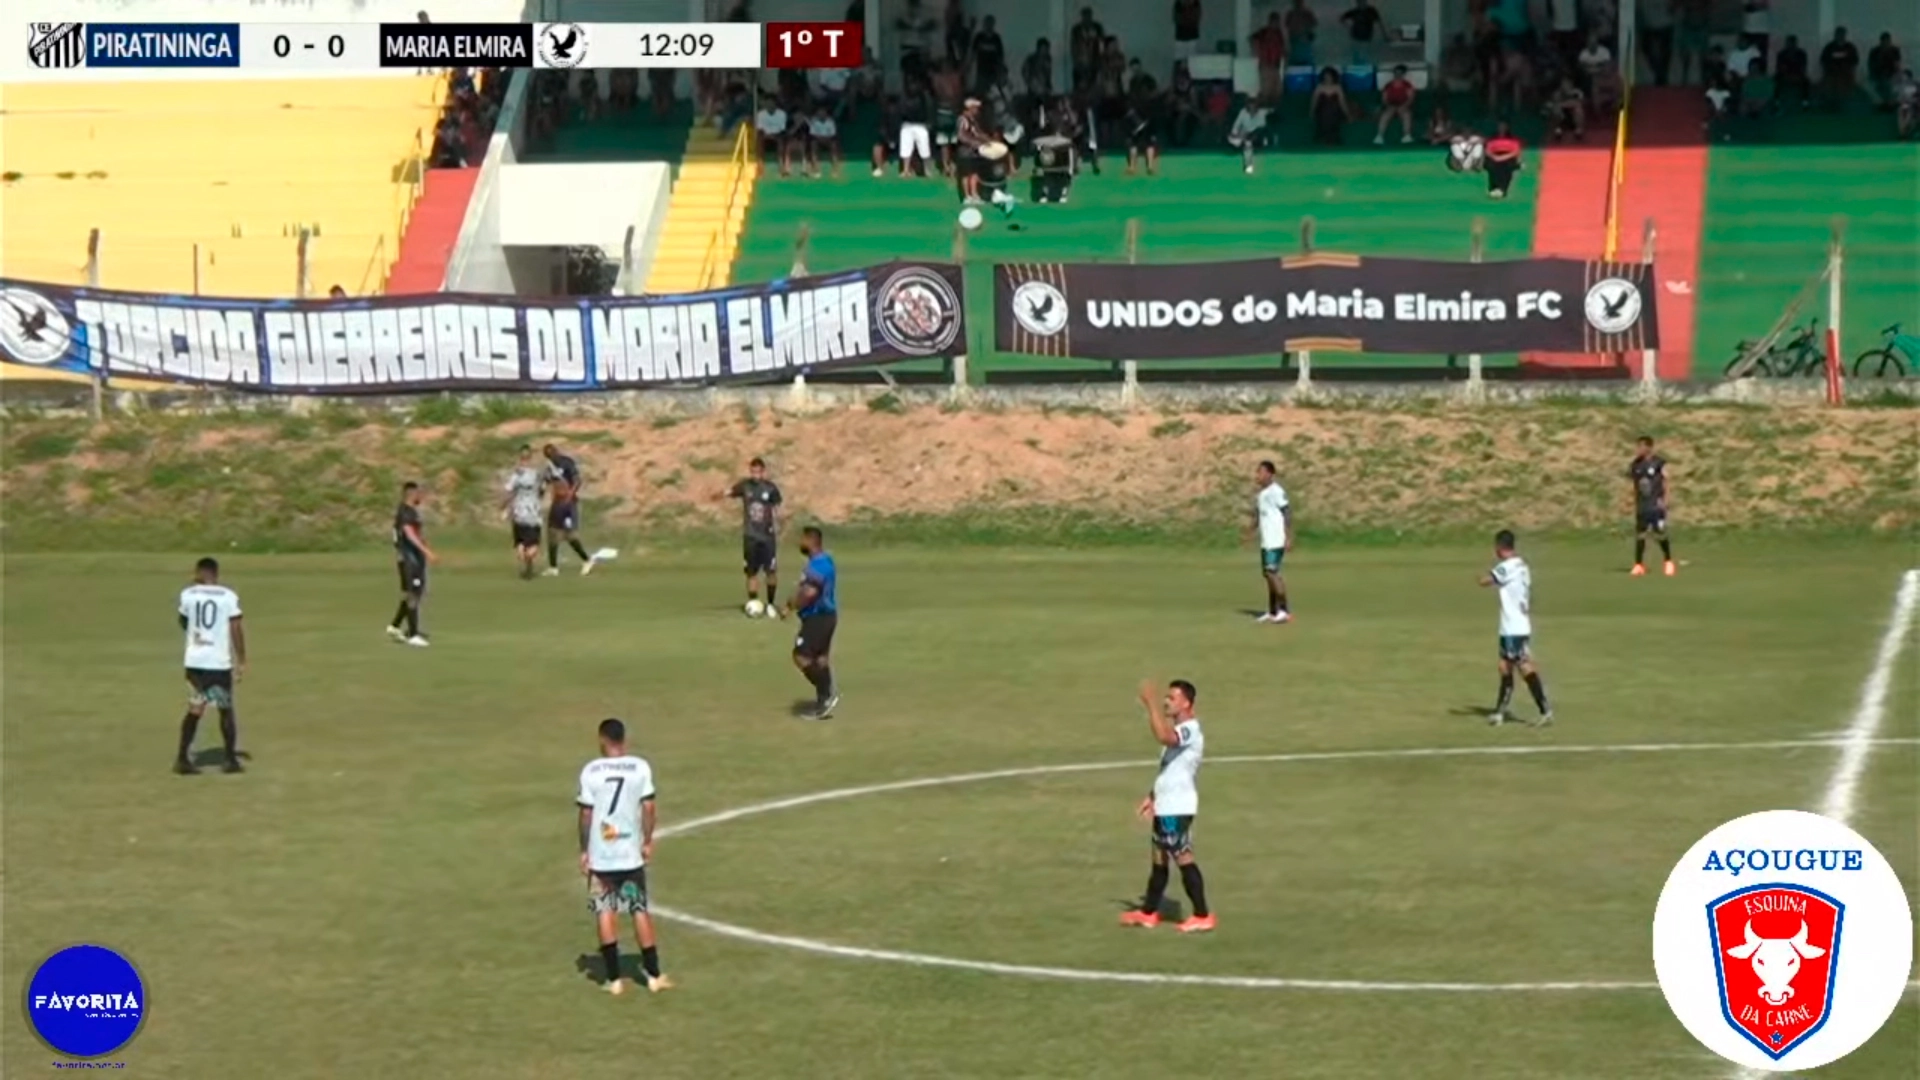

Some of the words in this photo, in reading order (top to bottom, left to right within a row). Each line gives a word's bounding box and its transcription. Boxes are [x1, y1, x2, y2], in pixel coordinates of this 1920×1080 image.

[1087, 300, 1223, 327] UNIDOS
[1232, 296, 1276, 324] do
[1286, 289, 1384, 319] Maria
[1395, 294, 1506, 320] Elmira
[1517, 292, 1562, 319] FC
[76, 300, 261, 384] TORCIDA
[264, 304, 520, 384] GUERREIROS
[525, 306, 586, 382] DO
[590, 300, 721, 382] MARIA
[726, 279, 872, 375] ELMIRA
[195, 599, 218, 630] 10
[604, 776, 625, 816] 7
